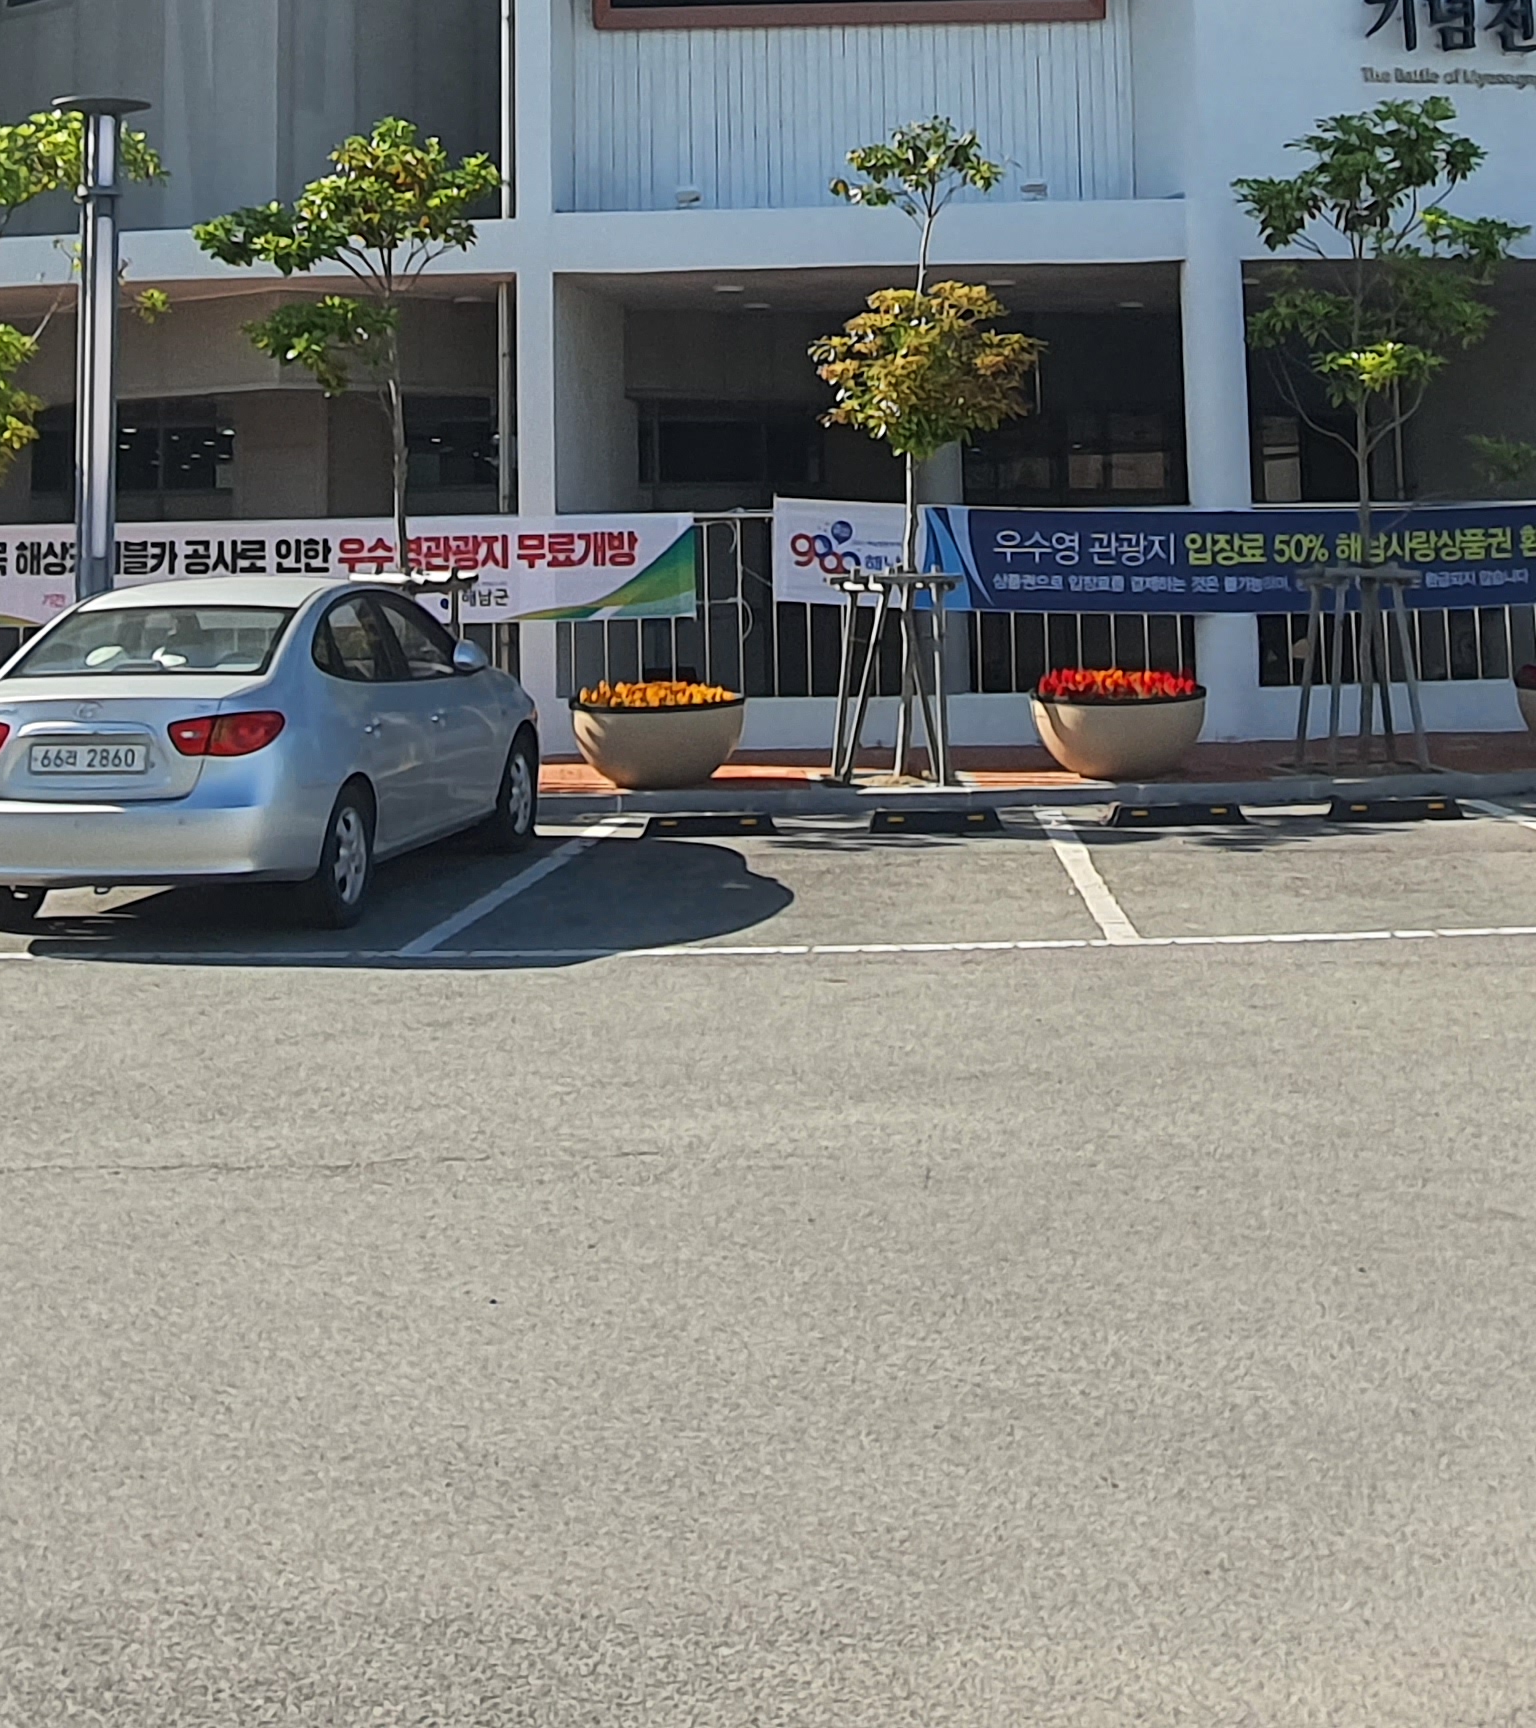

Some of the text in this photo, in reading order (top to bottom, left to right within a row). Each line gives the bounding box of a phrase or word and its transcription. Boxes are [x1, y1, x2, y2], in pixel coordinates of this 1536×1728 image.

[15, 538, 177, 576] 해상블카
[184, 538, 266, 575] 공사로
[275, 537, 332, 574] 인한
[517, 530, 639, 569] 무료개방
[993, 530, 1079, 566] 우수영
[1089, 532, 1175, 566] 관광지
[1184, 532, 1267, 566] 입장료
[1273, 533, 1329, 564] 50%
[86, 748, 135, 768] 2860
